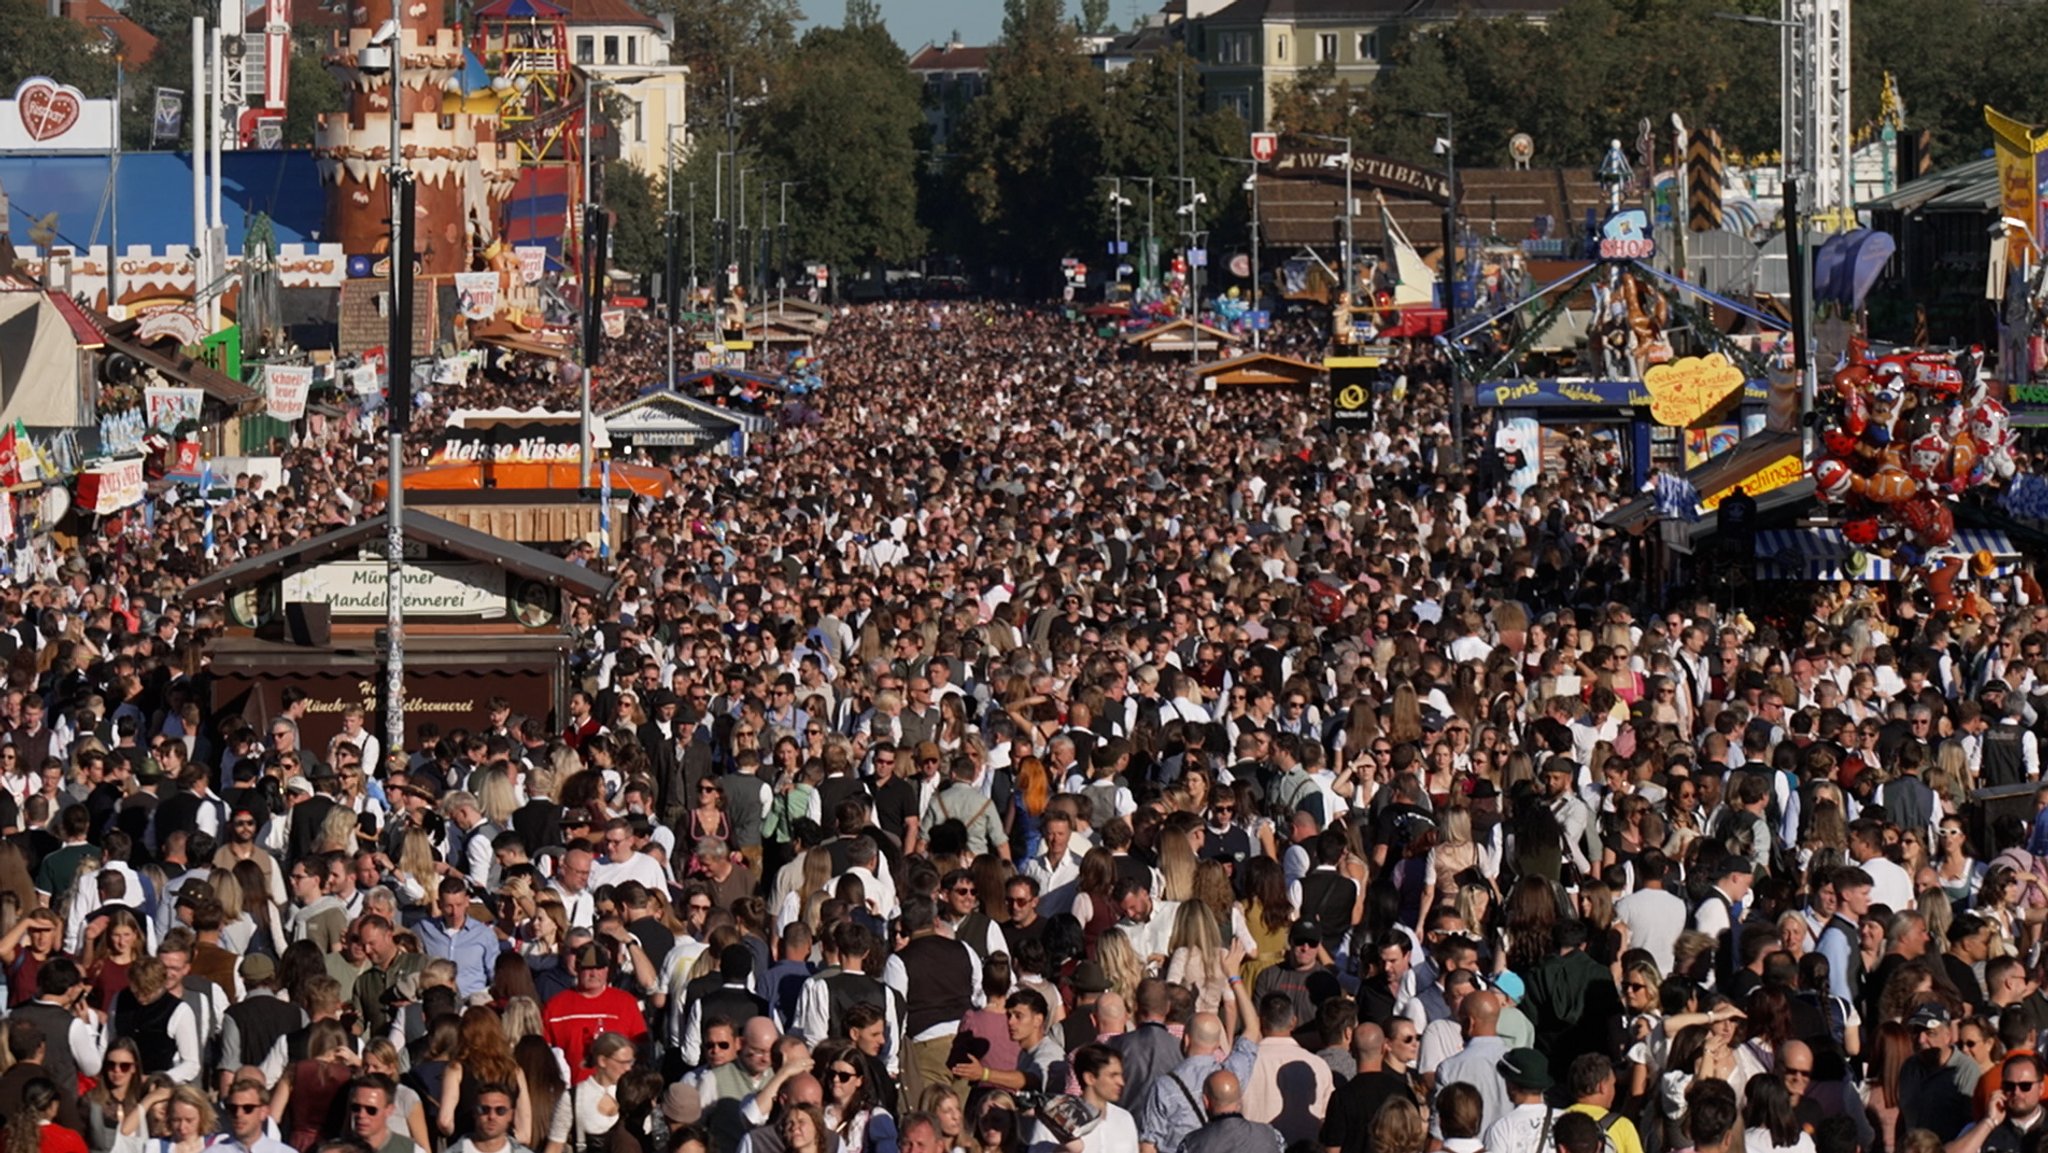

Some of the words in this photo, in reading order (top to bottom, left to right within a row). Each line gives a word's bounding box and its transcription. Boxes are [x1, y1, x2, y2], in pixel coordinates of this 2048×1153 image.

[1300, 153, 1437, 192] WIDSTUBEN
[1600, 239, 1653, 258] SHOP
[1496, 382, 1539, 405] Pins
[443, 438, 514, 461] Heisse
[517, 436, 581, 461] Nüsse
[352, 569, 435, 585] Münner
[325, 591, 465, 607] Mandelennerei
[303, 698, 361, 712] Münch
[363, 698, 474, 712] Melbrennerei
